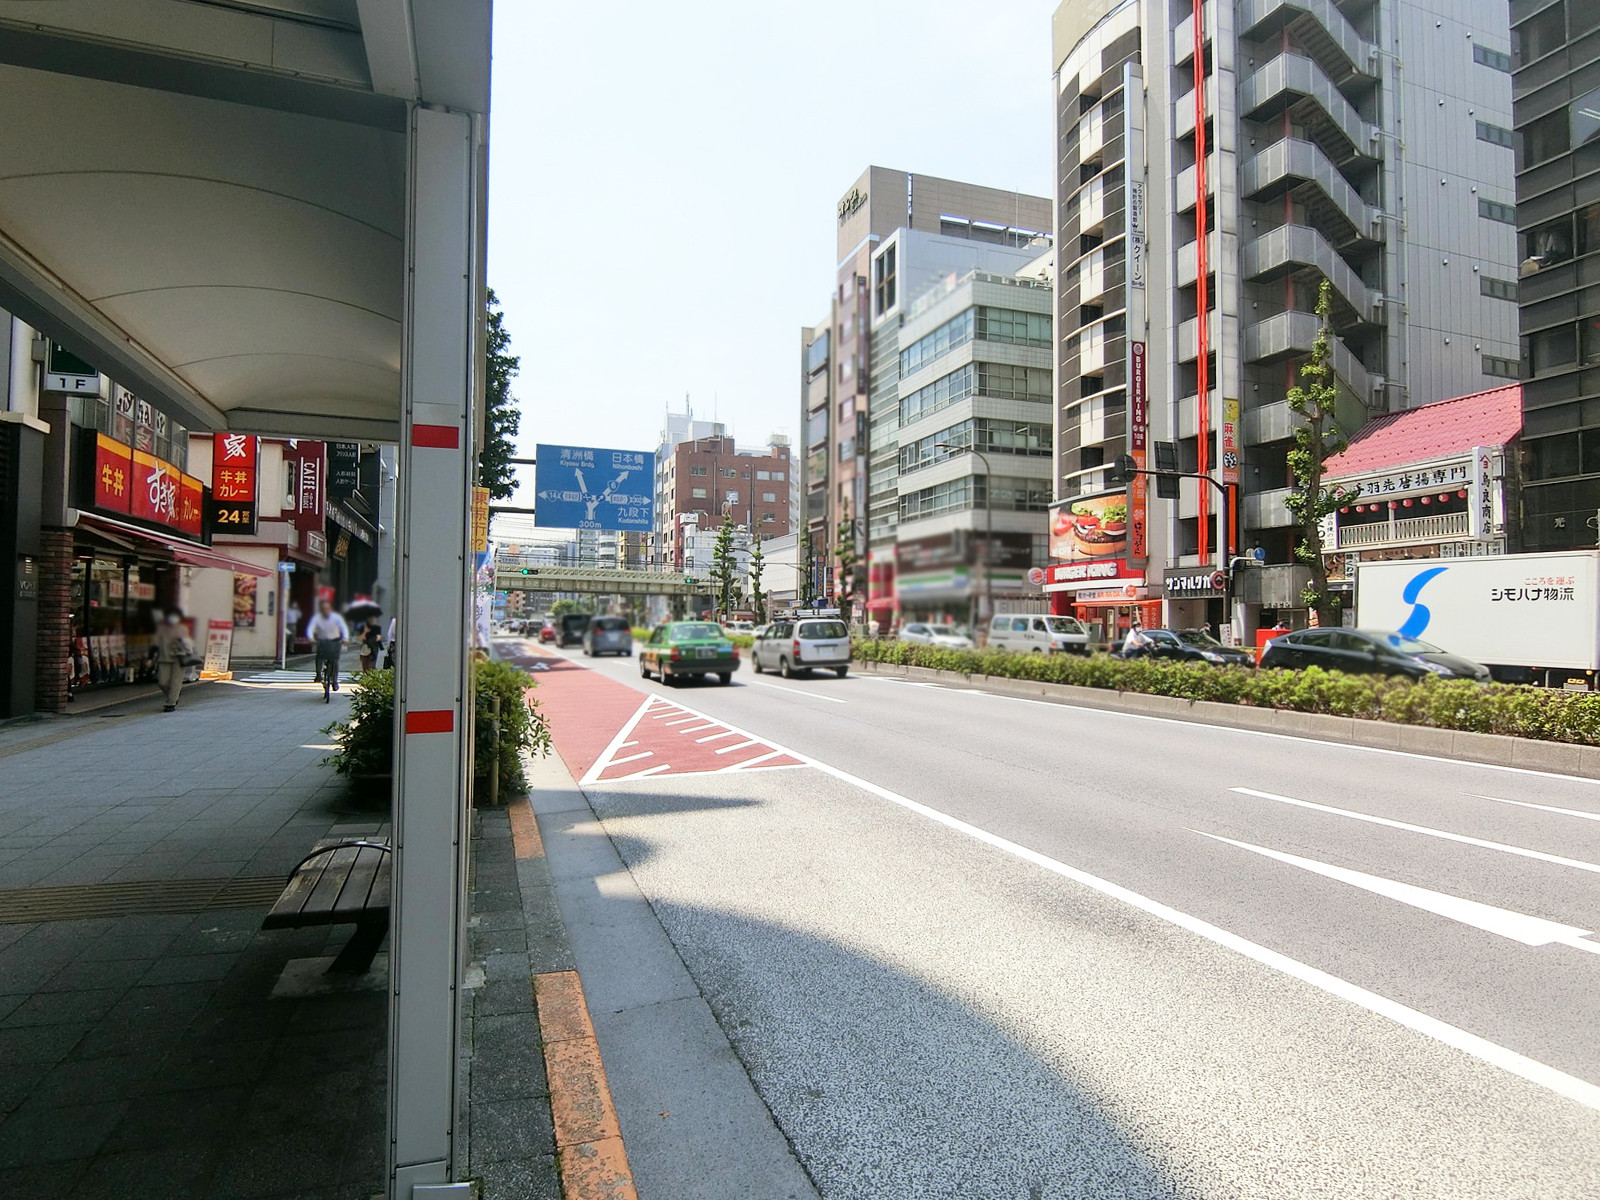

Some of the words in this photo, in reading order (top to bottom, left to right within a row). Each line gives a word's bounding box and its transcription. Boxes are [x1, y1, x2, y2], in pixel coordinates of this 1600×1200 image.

[1223, 422, 1234, 448] 麻雀
[223, 433, 247, 461] 家
[612, 452, 645, 464] 日本橋
[612, 463, 644, 471] Nihonbashi
[101, 463, 125, 498] 牛丼
[220, 470, 248, 484] 牛丼
[303, 462, 316, 490] CAFFE
[219, 484, 249, 498] カレー
[610, 480, 617, 489] 6
[1480, 471, 1492, 535] 鳥良商店
[217, 508, 241, 524] 24
[617, 506, 650, 518] 九段下
[578, 520, 602, 529] 300m
[617, 517, 649, 525] Kudanshita
[1554, 516, 1566, 529] 光
[1524, 576, 1575, 586] こころを運ぶ
[1491, 587, 1575, 602] シモハナ物流
